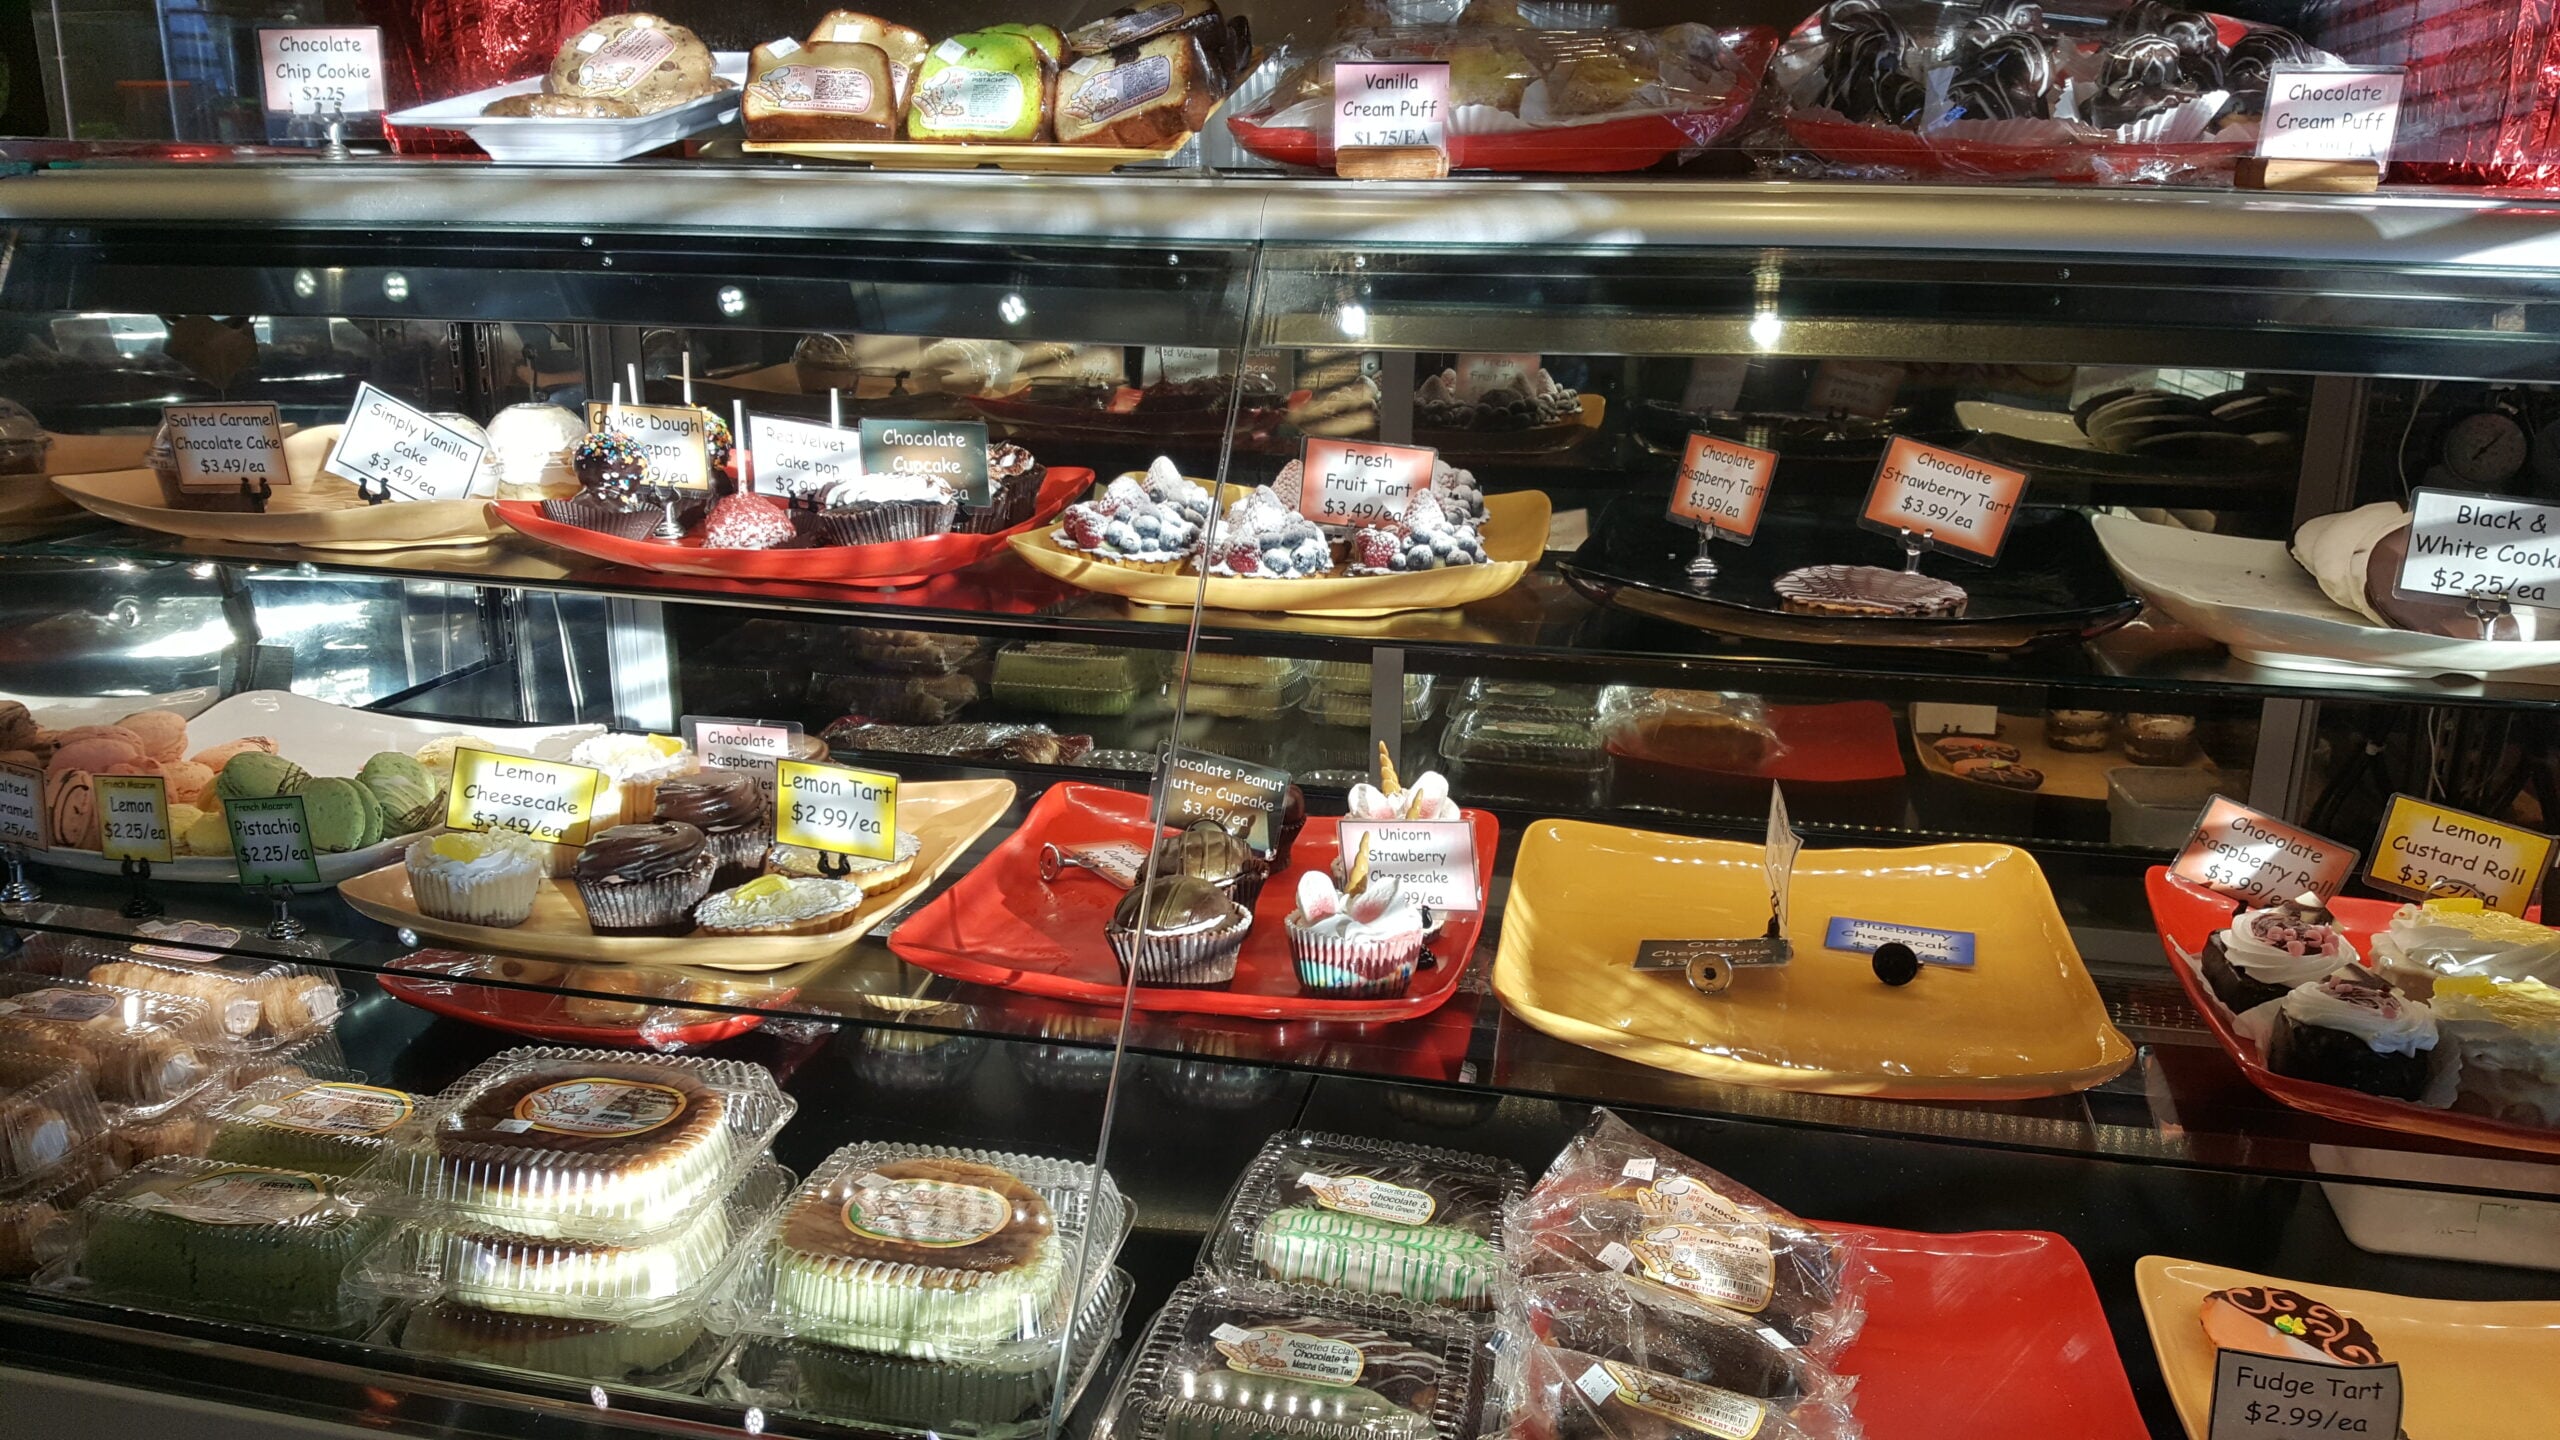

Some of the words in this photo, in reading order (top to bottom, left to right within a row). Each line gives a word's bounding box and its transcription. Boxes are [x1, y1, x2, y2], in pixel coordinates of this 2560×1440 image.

[280, 35, 361, 52] Chocolate
[276, 63, 311, 83] Chip
[317, 63, 371, 79] Cookie
[1365, 73, 1418, 90] Vanilla
[302, 86, 345, 101] $2.25
[2288, 83, 2382, 101] Chocolate
[1343, 101, 1394, 117] Cream
[1400, 100, 1437, 118] Puff
[2276, 112, 2335, 129] Cream
[2342, 112, 2385, 131] Puff
[1354, 129, 1429, 145] $1.75/EA
[170, 412, 216, 428] Salted
[220, 412, 275, 427] Caramel
[593, 410, 645, 429] Cokie
[650, 414, 700, 437] Dough
[175, 435, 243, 450] Chocolate
[247, 435, 280, 449] Cake
[370, 403, 418, 438] Simply
[423, 427, 468, 462] Vanilla
[766, 426, 794, 444] Red
[800, 432, 845, 453] Velvet
[882, 428, 966, 448] Chocolate
[393, 440, 428, 466] Cake
[1344, 448, 1393, 469] Fresh
[1702, 444, 1755, 470] Chocolate
[201, 458, 265, 474] $3.49/ea
[368, 452, 436, 496] $3.49/ea
[775, 453, 810, 471] Cake
[815, 462, 840, 478] pop
[892, 456, 961, 474] Cupcake
[1917, 452, 1992, 485] Chocolate
[1325, 473, 1368, 493] Fruit
[1374, 478, 1412, 498] Tart
[1681, 463, 1736, 494] Raspberry
[1740, 478, 1765, 499] Tart
[1882, 466, 1972, 506] Strawberry
[1978, 493, 2012, 516] Tart
[1323, 498, 1403, 523] $3.49/ea
[1689, 490, 1740, 518] $3.99/ea
[1901, 495, 1974, 529] $3.99/ea
[2457, 505, 2522, 531] Black
[2530, 513, 2547, 534] &
[2416, 533, 2488, 560] White
[2431, 567, 2545, 601] $2.25/ea
[708, 731, 775, 748] Chocolate
[494, 761, 556, 785] Lemon
[1235, 769, 1284, 793] Peanut
[0, 780, 28, 797] alted
[781, 768, 841, 796] Lemon
[848, 779, 892, 804] Tart
[1170, 778, 1212, 796] utter
[1216, 787, 1274, 812] Cupcake
[110, 796, 153, 813] Lemon
[262, 802, 294, 810] Macaron
[463, 784, 578, 815] Cheesecake
[0, 803, 33, 819] ramel
[791, 801, 881, 834] $2.99/ea
[1182, 798, 1248, 827] $3.49/ea
[104, 822, 166, 841] $2.25/ea
[234, 818, 301, 836] Pistachio
[1379, 828, 1431, 841] Unicorn
[2432, 816, 2501, 849] Lemon
[2232, 817, 2323, 864] Chocolate
[241, 844, 309, 865] $2.25/ea
[1369, 850, 1447, 866] Strawberry
[2195, 830, 2292, 883] Raspberry
[2295, 871, 2335, 897] Roll
[2392, 836, 2478, 871] Custard
[2483, 859, 2527, 885] Roll
[1853, 921, 1952, 942] Blueberry
[1369, 1192, 1418, 1207] Chocolate
[1421, 1201, 1428, 1209] &
[1373, 1185, 1407, 1197] Assorted
[1407, 1192, 1428, 1201] Eclair
[1370, 1201, 1394, 1211] Matcha
[1395, 1205, 1415, 1214] Green
[1417, 1208, 1429, 1217] Tea
[1700, 1237, 1762, 1253] CHOCOLATE
[1717, 1289, 1745, 1302] BAKERY
[1746, 1297, 1760, 1305] INC
[1288, 1339, 1330, 1353] Assorted
[1331, 1345, 1357, 1356] Eclair
[1293, 1349, 1341, 1362] Chocolate
[1342, 1356, 1349, 1364] &
[1292, 1360, 1316, 1371] Matcha
[1317, 1364, 1339, 1374] Green
[1340, 1368, 1353, 1376] Tea
[2237, 1366, 2314, 1398] Fudge
[2327, 1378, 2384, 1400] Tart
[1697, 1416, 1728, 1430] BAKERY
[1729, 1426, 1745, 1435] INC
[2245, 1400, 2367, 1432] $2.99/ea
